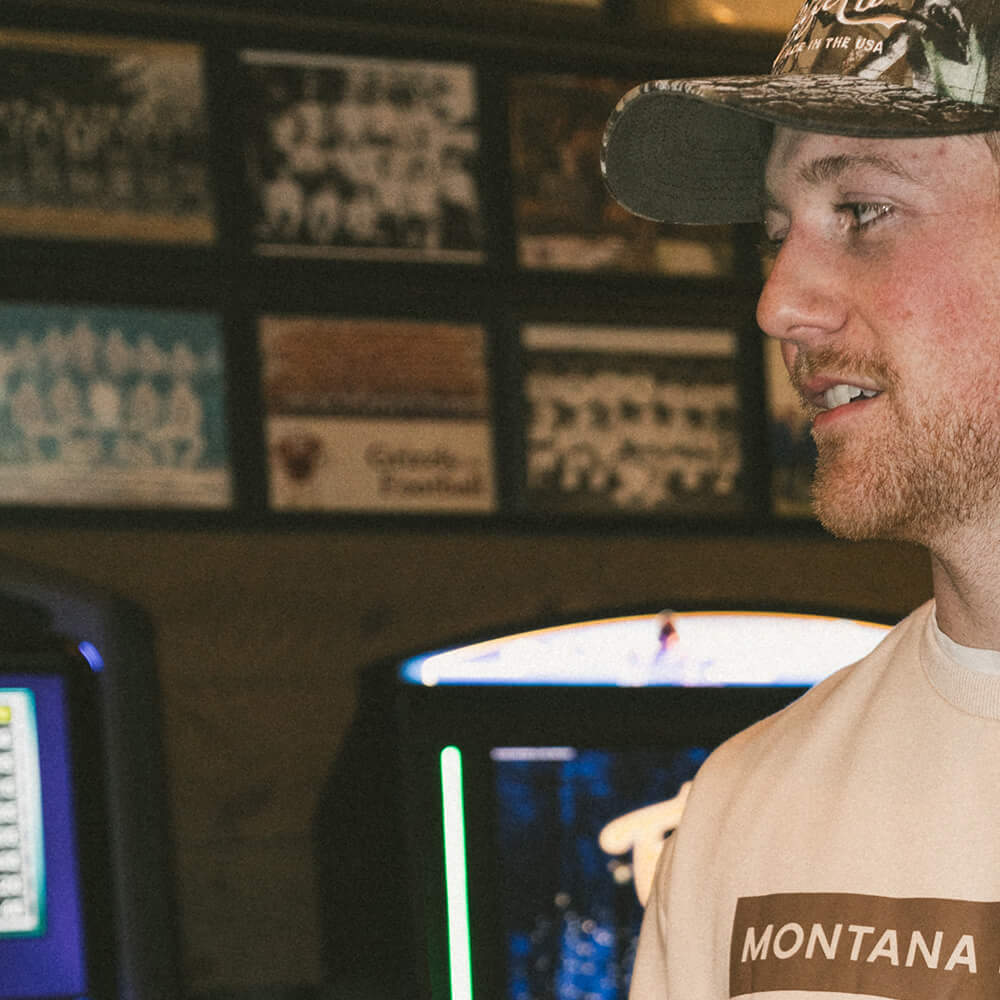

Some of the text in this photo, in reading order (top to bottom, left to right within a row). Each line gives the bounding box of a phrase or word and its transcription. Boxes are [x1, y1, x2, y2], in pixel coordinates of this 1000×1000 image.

[807, 38, 822, 50] IN
[825, 36, 852, 49] THE
[855, 37, 884, 55] USA
[741, 922, 977, 974] MONTANA
